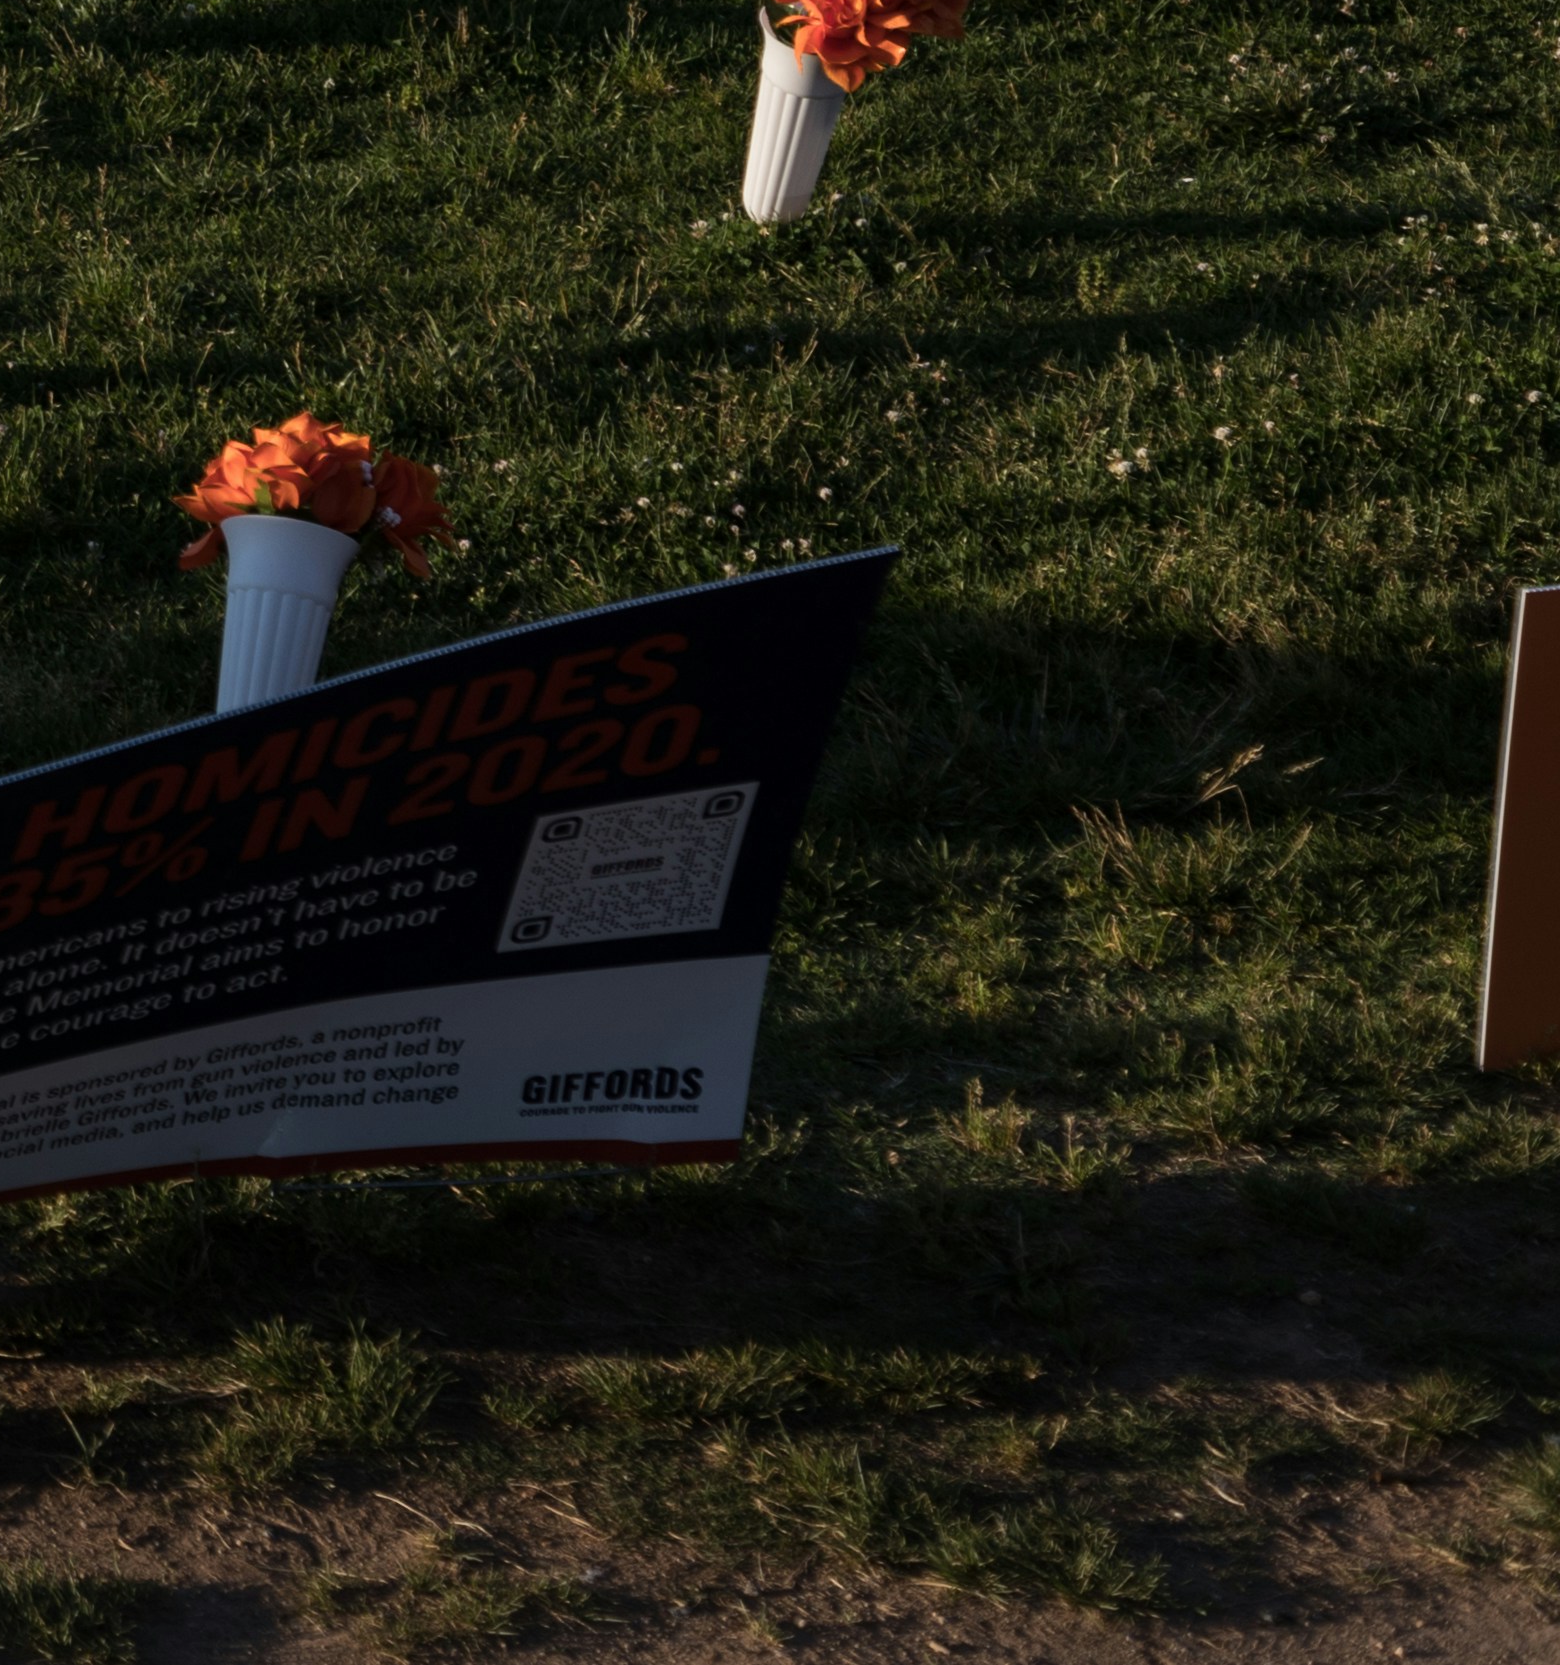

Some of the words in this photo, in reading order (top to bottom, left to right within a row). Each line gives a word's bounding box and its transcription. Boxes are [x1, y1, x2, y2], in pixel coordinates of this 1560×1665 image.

[13, 632, 689, 864] HOMICIDES
[238, 776, 371, 863] IN
[387, 704, 721, 827] 2020.
[157, 906, 192, 928] to
[200, 876, 303, 917] rising
[310, 843, 458, 889] violence
[591, 856, 664, 875] GIFFORDS
[2, 956, 107, 996] alone.
[119, 942, 147, 965] It
[154, 907, 286, 955] doesn't
[293, 888, 379, 921] have
[389, 879, 424, 900] to
[432, 869, 478, 892] be
[26, 954, 194, 1016] Memorial
[199, 938, 284, 971] aims
[294, 927, 328, 949] to
[337, 905, 446, 940] honor
[28, 992, 172, 1041] courage
[182, 981, 216, 1003] to
[224, 964, 288, 993] act.
[21, 1091, 40, 1104] is
[46, 1059, 167, 1099] sponsored
[172, 1056, 200, 1070] by
[205, 1034, 303, 1064] Giffords,
[310, 1031, 325, 1044] a
[331, 1016, 441, 1041] nonprofit
[73, 1089, 126, 1109] lives
[132, 1077, 185, 1097] from
[189, 1067, 234, 1090] gun
[240, 1050, 337, 1076] violence
[342, 1041, 388, 1061] and
[394, 1038, 430, 1056] led
[436, 1036, 464, 1054] by
[76, 1097, 174, 1126] Giffords.
[183, 1088, 218, 1106] We
[224, 1076, 287, 1098] invite
[293, 1071, 335, 1090] you
[343, 1068, 366, 1083] to
[372, 1061, 459, 1082] explore
[522, 1067, 704, 1104] GIFFORDS
[49, 1126, 124, 1149] media,
[131, 1112, 176, 1134] and
[181, 1105, 230, 1125] help
[237, 1100, 264, 1116] us
[270, 1087, 366, 1109] demand
[372, 1085, 458, 1104] change
